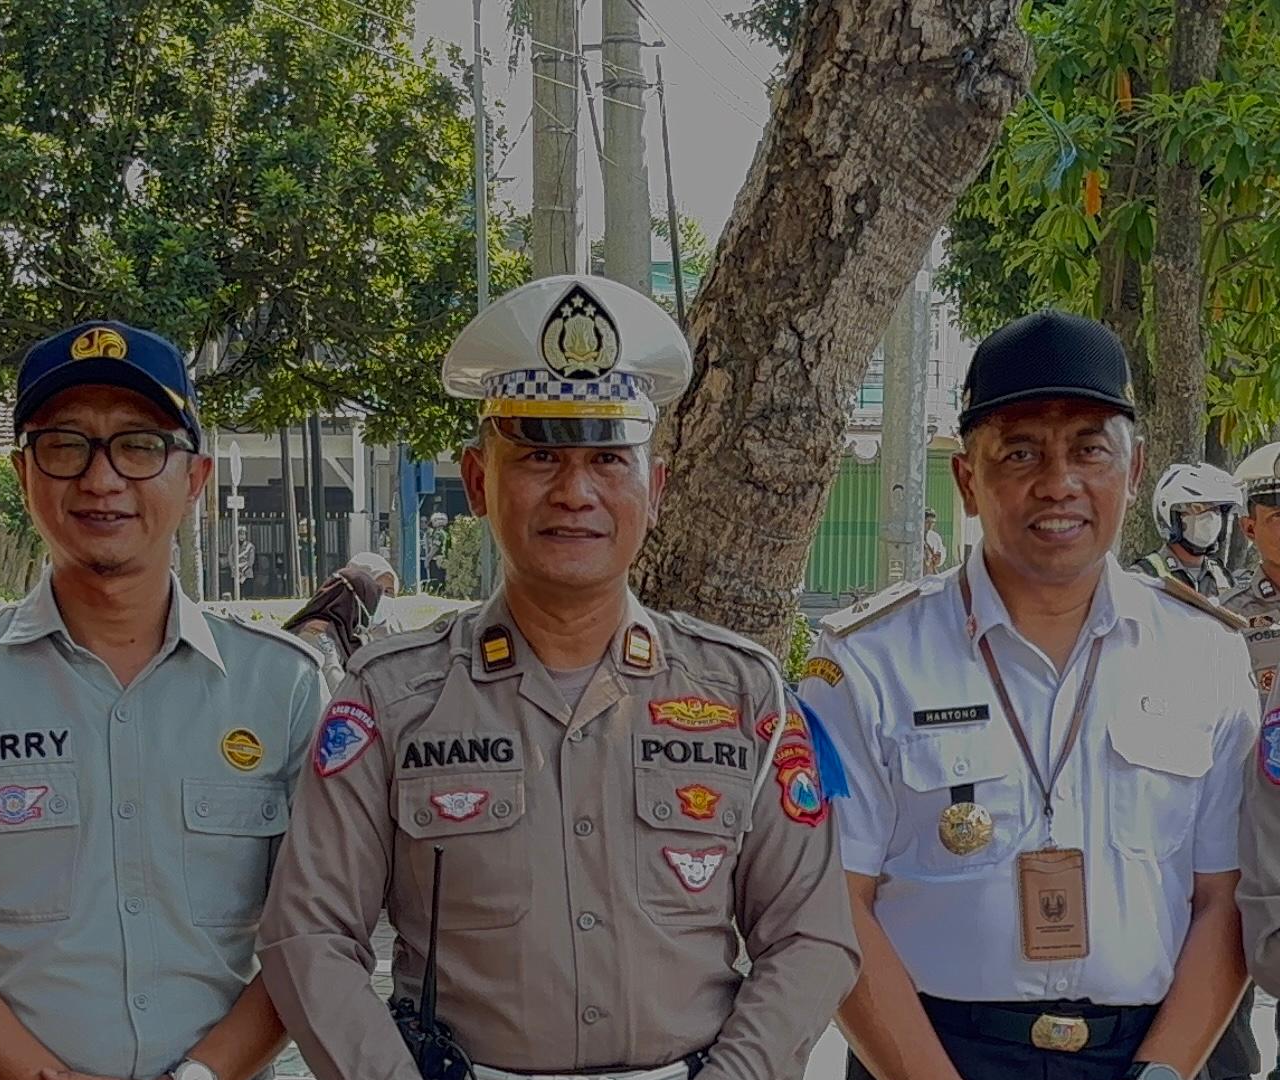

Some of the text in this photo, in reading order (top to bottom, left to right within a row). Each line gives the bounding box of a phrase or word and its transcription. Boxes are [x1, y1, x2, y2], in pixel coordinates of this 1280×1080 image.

[925, 708, 977, 722] HARTONO
[401, 737, 514, 769] ANANG
[641, 738, 748, 771] POLRI
